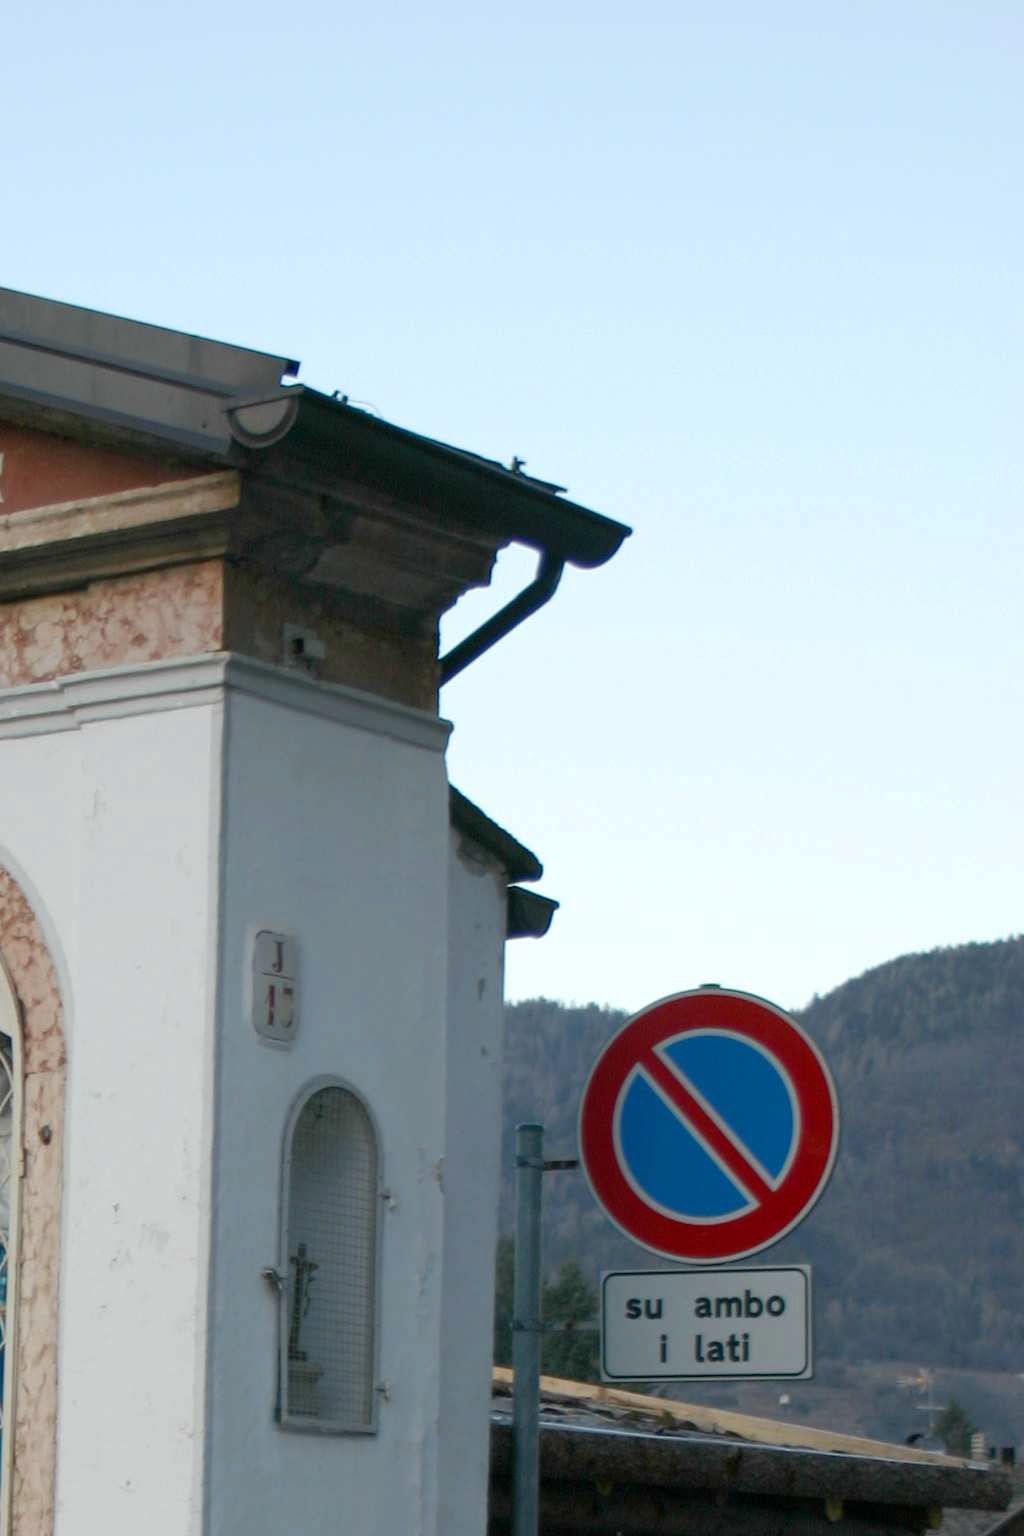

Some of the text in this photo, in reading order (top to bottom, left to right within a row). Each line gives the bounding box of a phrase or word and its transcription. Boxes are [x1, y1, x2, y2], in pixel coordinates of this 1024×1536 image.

[625, 1289, 786, 1320] su ambo
[659, 1333, 750, 1363] i lati
